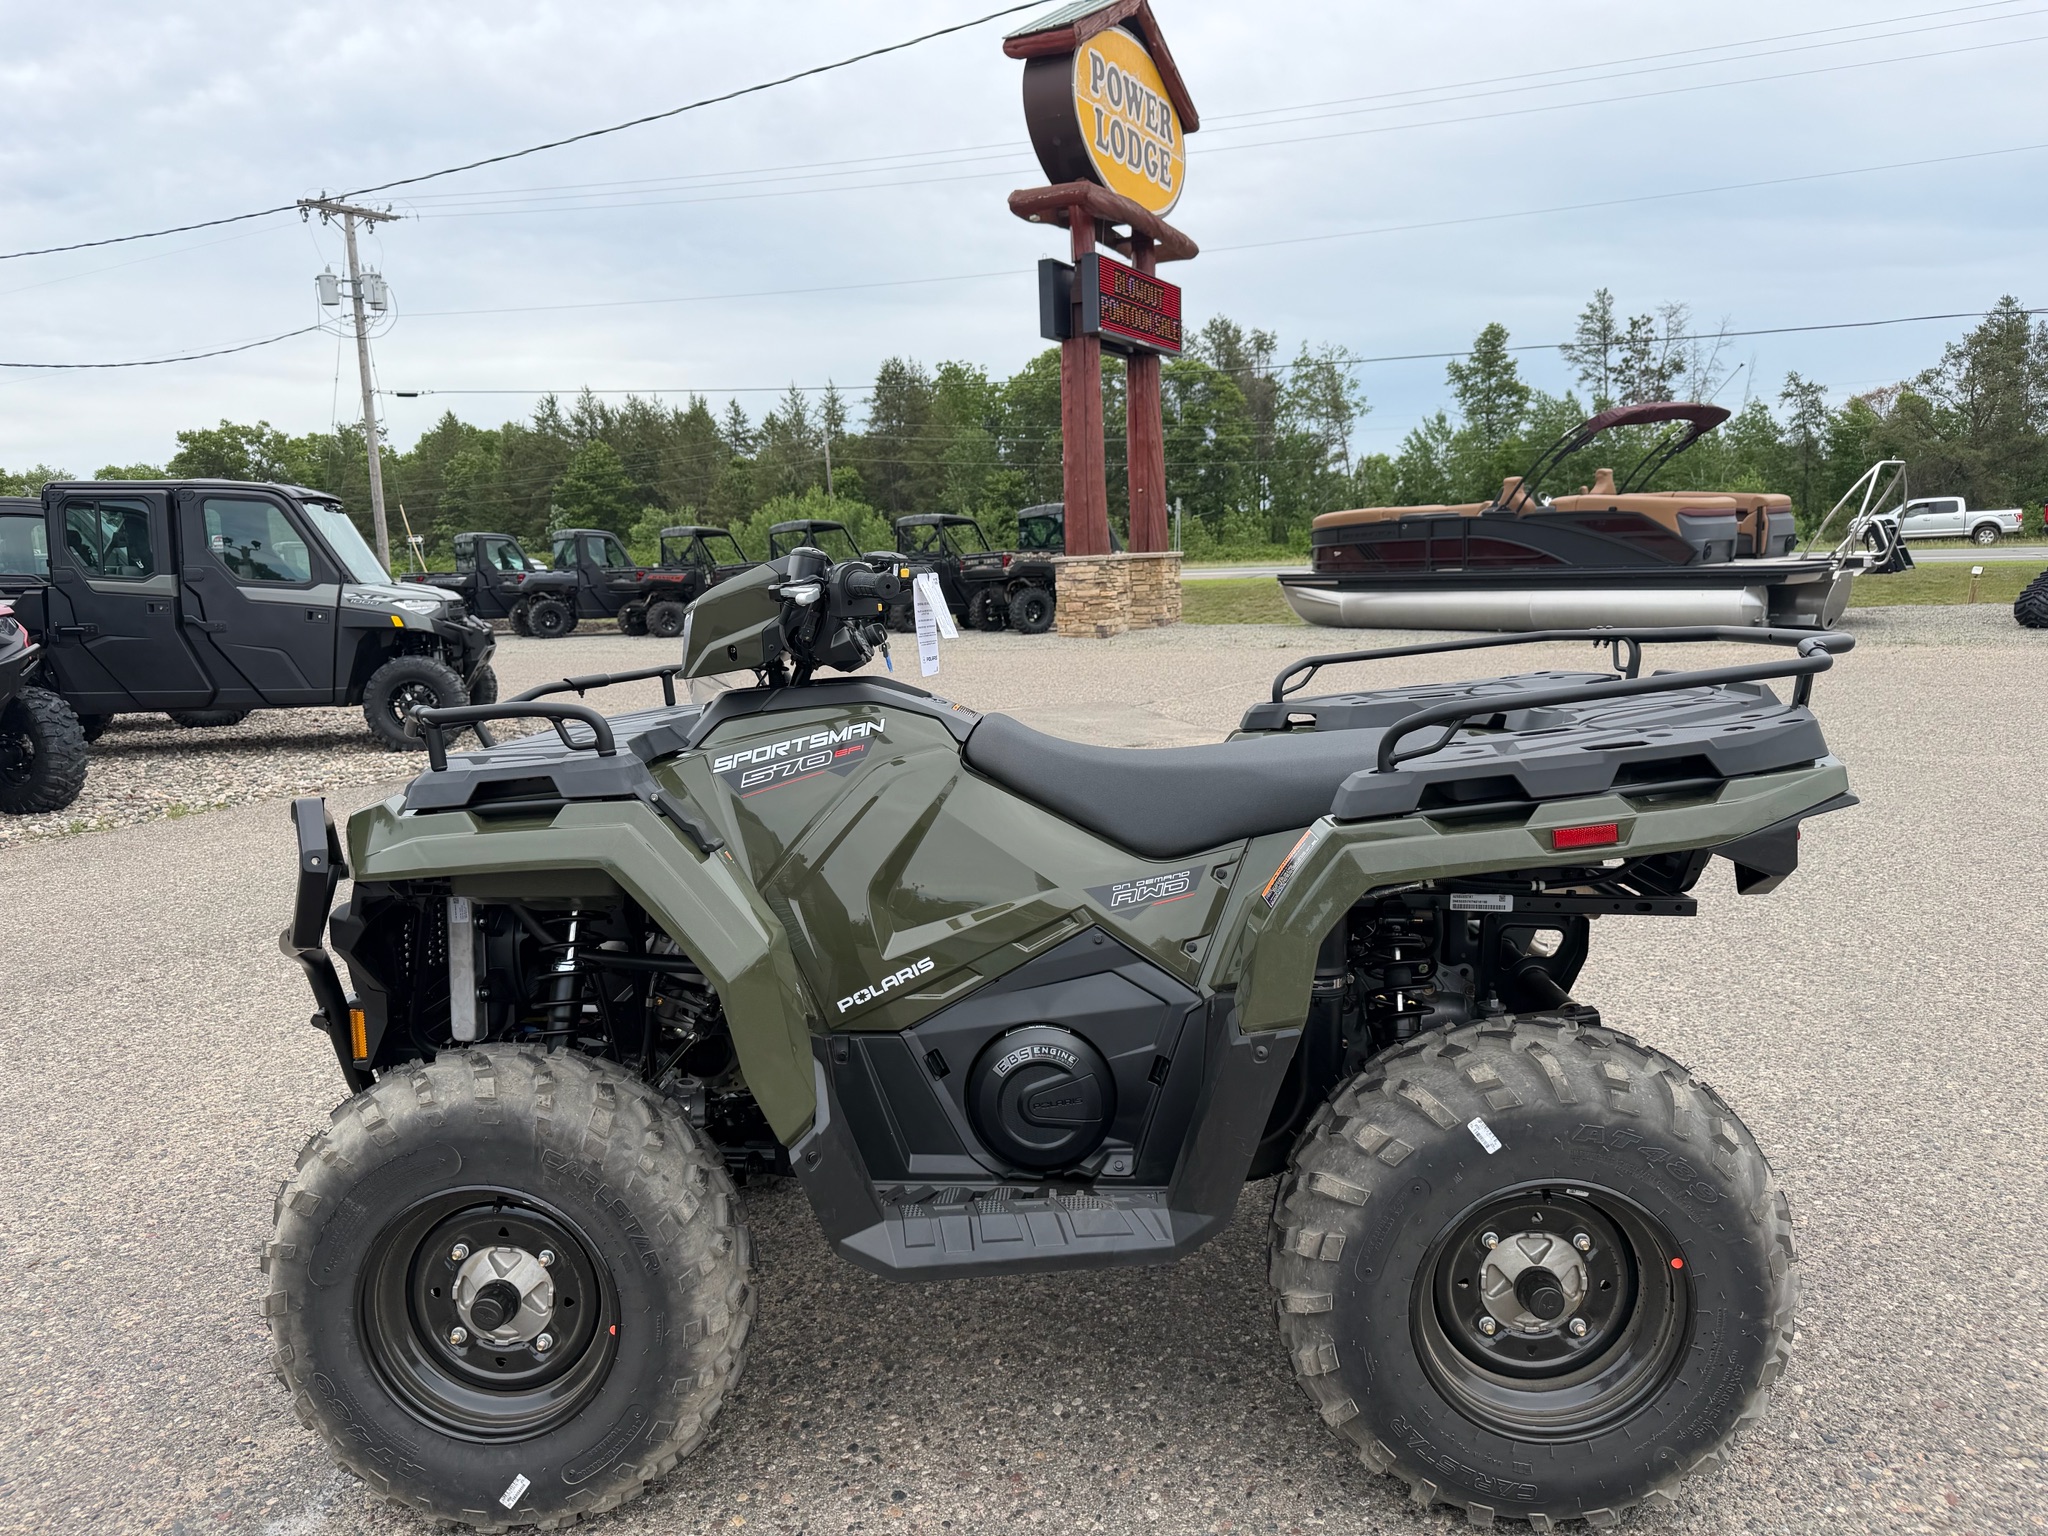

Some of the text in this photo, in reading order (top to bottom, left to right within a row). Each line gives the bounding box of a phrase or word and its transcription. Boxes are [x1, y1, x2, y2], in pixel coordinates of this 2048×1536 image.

[1089, 49, 1175, 146] POWER
[1094, 106, 1173, 190] LODGE
[1114, 270, 1164, 311] BLOWOUT
[713, 718, 886, 774] SPORTSMAN
[740, 744, 865, 788] 570 EFI
[1111, 878, 1190, 907] AWD
[1112, 871, 1190, 892] ON DEMAND
[836, 956, 935, 1013] POLARIS
[996, 1046, 1076, 1074] EBS ENGINE
[1033, 1097, 1083, 1110] POLARIS
[541, 1148, 660, 1272] CARLSTAR
[1390, 1415, 1538, 1500] CARLSTAR
